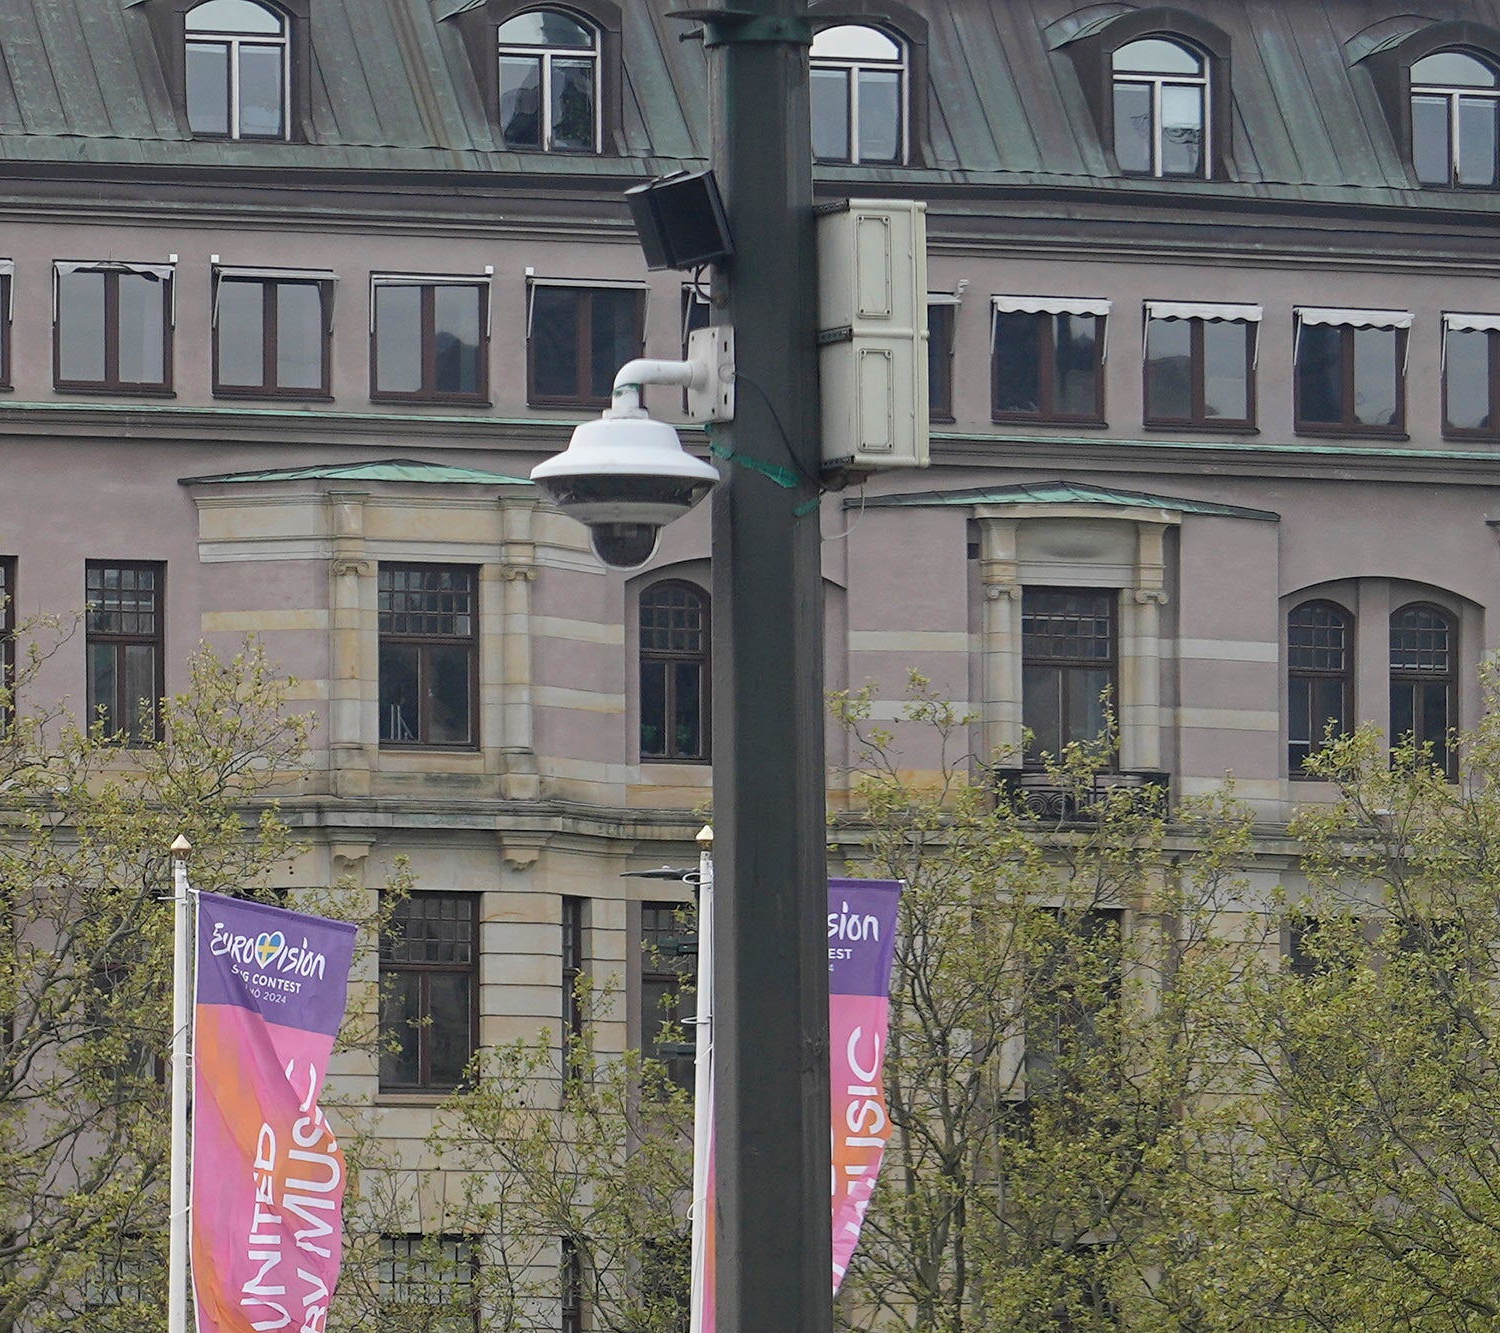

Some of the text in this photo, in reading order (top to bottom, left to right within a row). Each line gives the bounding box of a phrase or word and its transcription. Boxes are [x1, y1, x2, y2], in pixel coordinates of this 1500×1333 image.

[251, 973, 302, 995] CONTEST
[263, 990, 288, 1005] 2024
[282, 1057, 343, 1260] MUSC
[239, 1122, 292, 1332] UNITED
